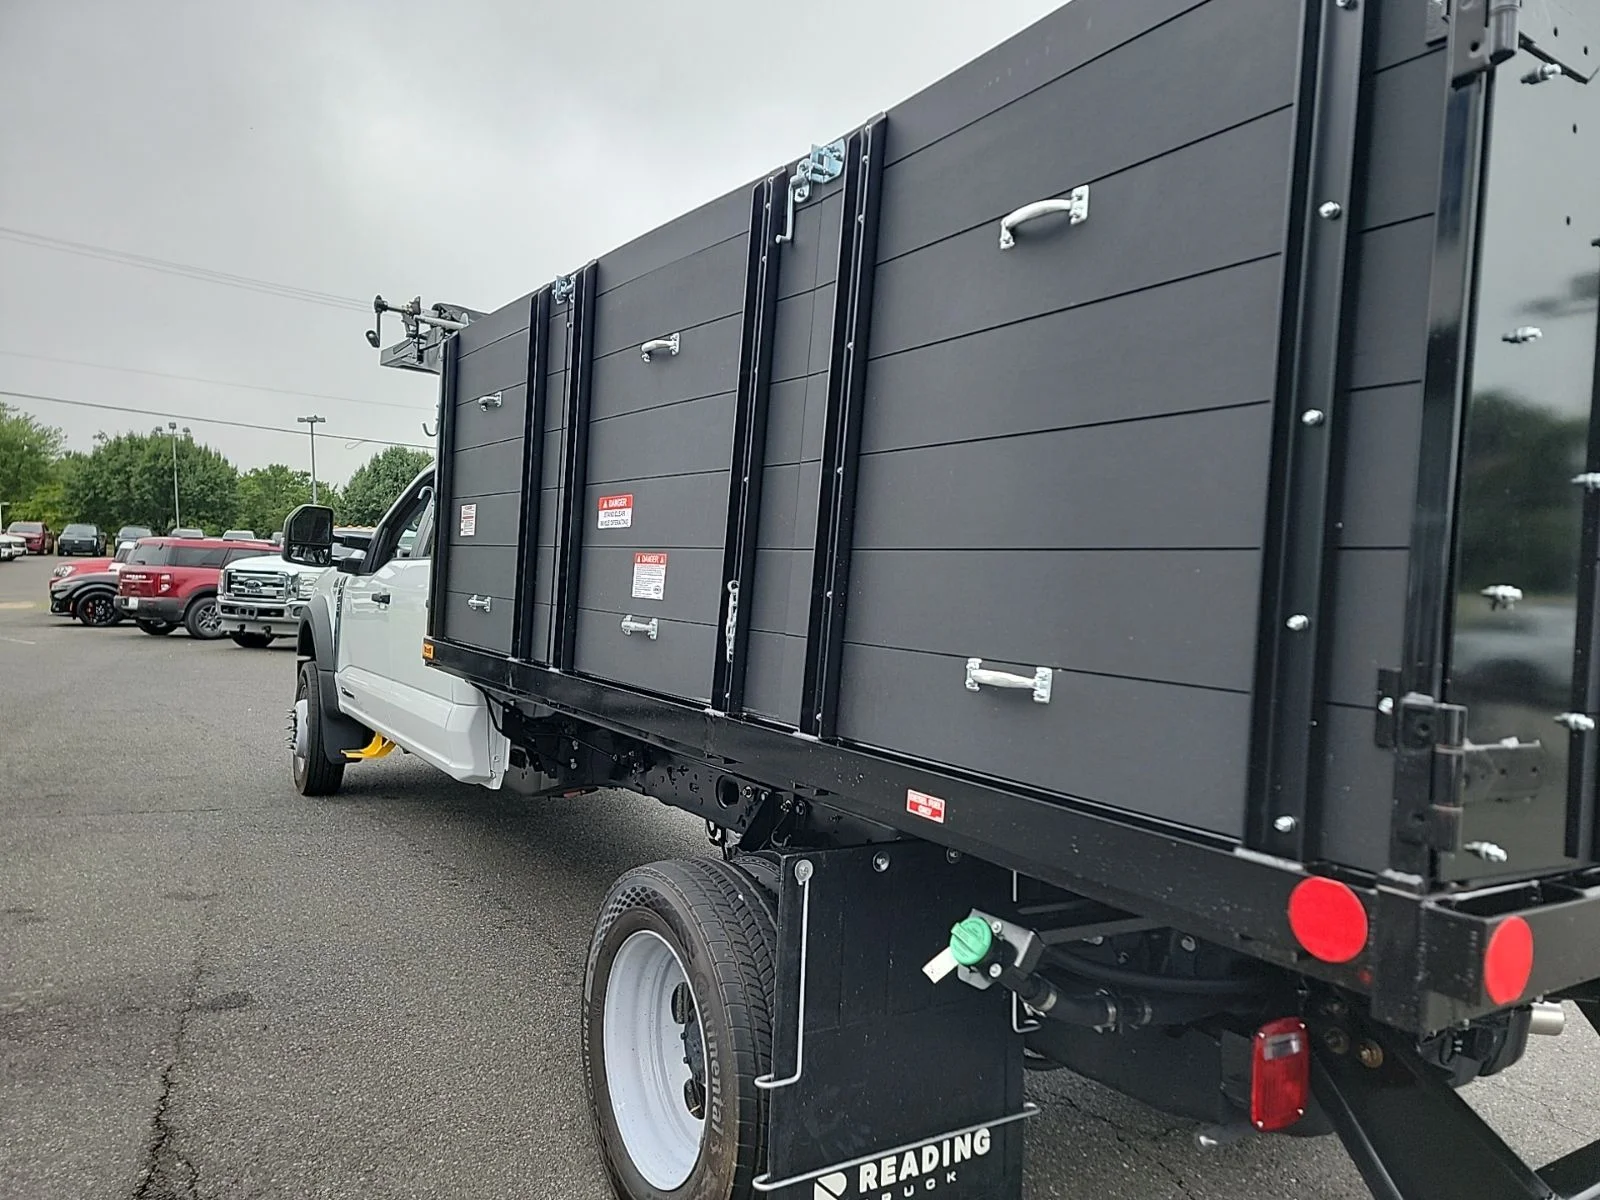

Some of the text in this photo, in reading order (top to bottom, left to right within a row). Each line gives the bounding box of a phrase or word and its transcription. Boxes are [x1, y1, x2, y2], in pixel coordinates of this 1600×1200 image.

[609, 498, 628, 508] DANGER
[641, 554, 659, 563] DANGER
[859, 1127, 992, 1194] READING
[865, 1171, 957, 1200] RUCK
